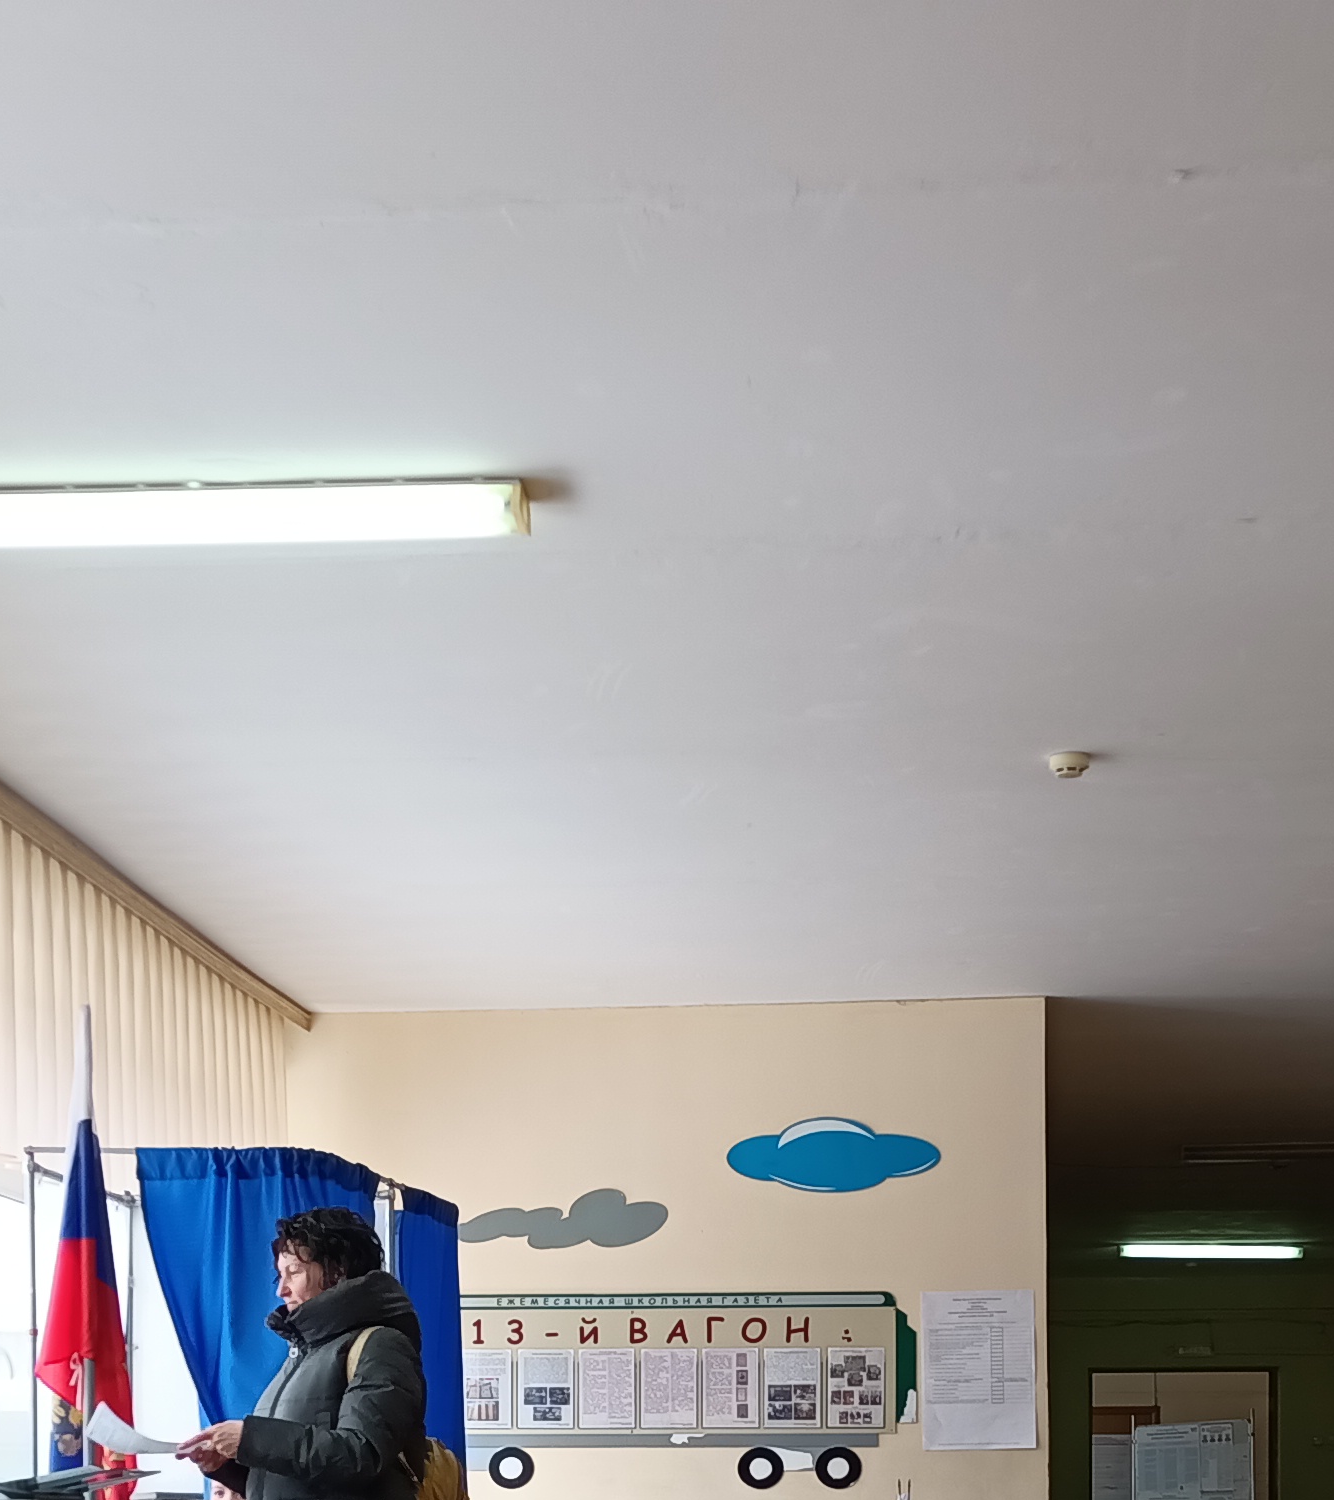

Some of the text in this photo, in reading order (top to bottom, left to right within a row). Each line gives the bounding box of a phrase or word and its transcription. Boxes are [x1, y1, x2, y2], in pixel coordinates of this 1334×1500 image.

[496, 1295, 783, 1306] ЕЖЕМЕСЯЧНАЯ ШКОЛЬНАЯ ГАЗЕТА
[629, 1316, 810, 1344] ВАГОН
